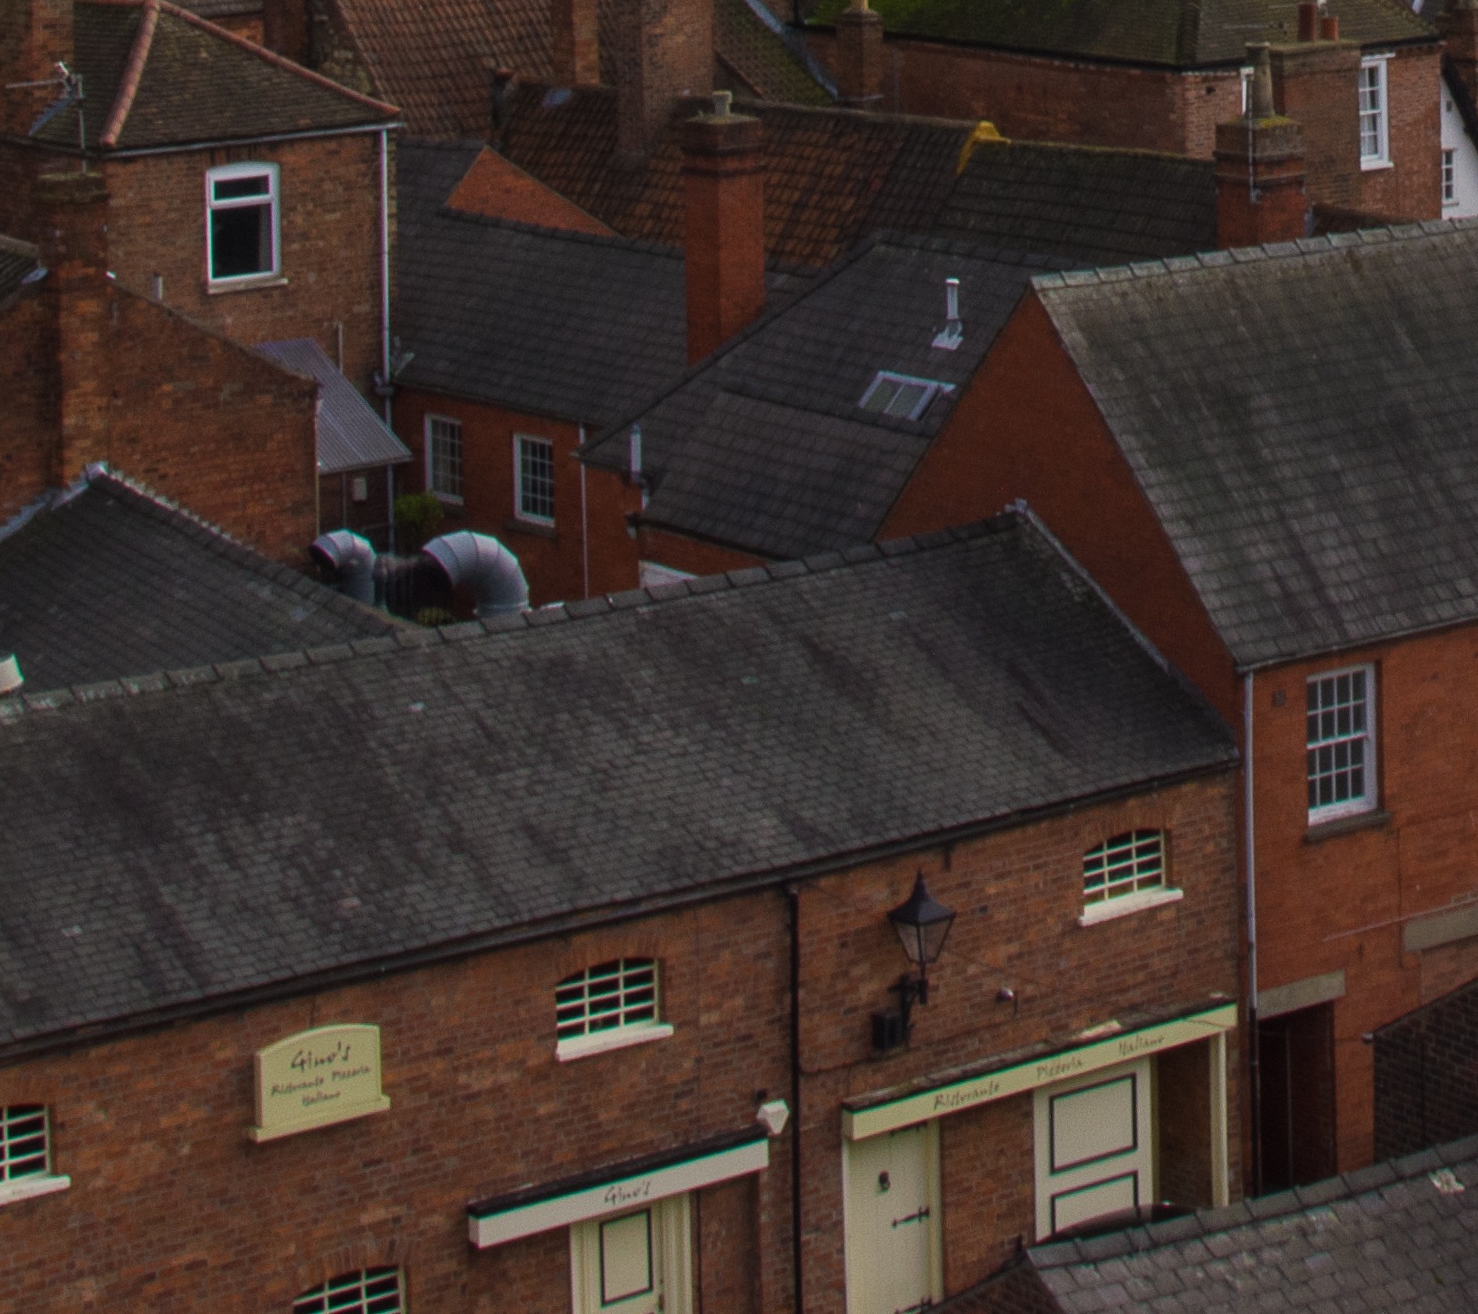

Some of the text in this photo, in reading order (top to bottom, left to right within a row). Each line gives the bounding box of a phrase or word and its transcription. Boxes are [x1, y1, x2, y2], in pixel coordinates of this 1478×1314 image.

[290, 1040, 351, 1073] Gino's
[933, 1035, 1165, 1110] Ristorante Pizzeria Italiano
[604, 1179, 652, 1204] Gino's
